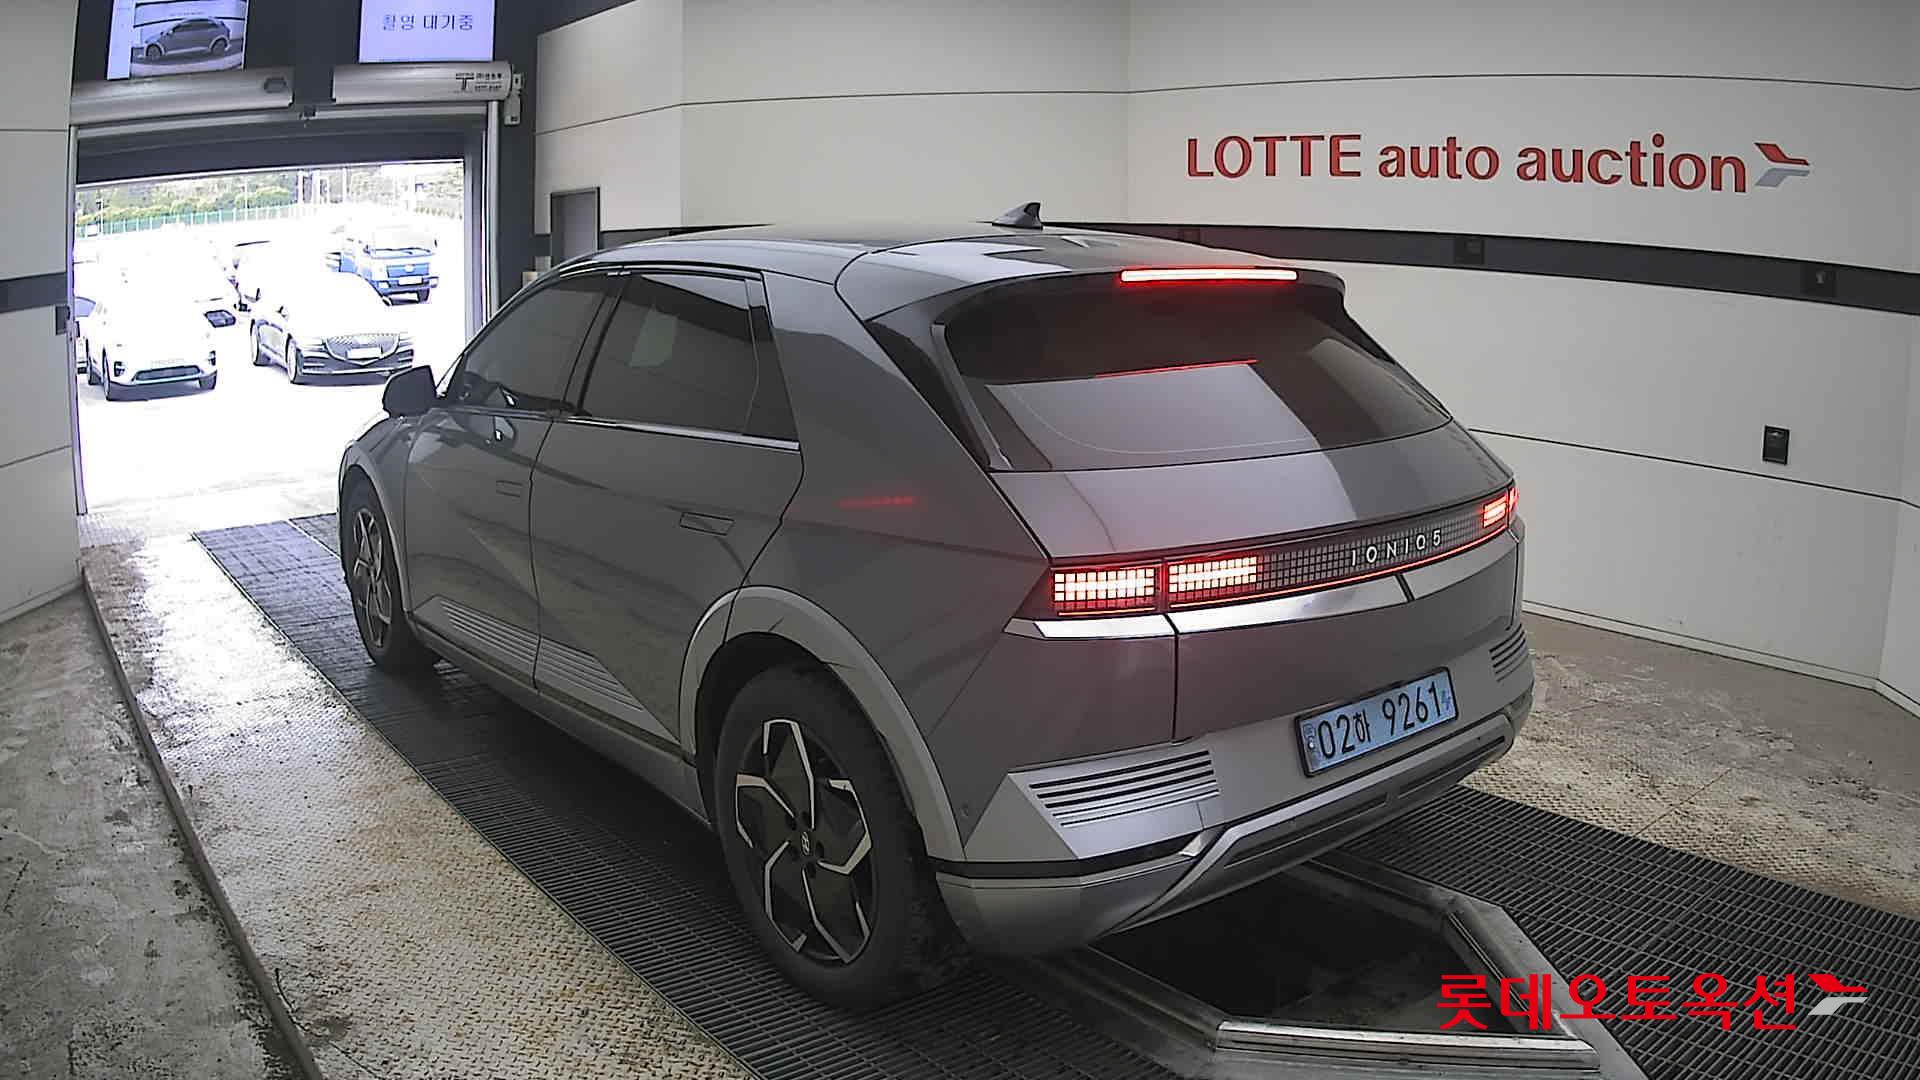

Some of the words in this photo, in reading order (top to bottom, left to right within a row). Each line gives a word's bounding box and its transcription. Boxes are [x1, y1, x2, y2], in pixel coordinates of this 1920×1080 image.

[423, 14, 473, 31] 대기중
[1187, 135, 1360, 177] LOTTE
[1379, 136, 1500, 179] auto
[1516, 134, 1747, 192] auction
[1317, 708, 1372, 759] 02하
[1381, 681, 1442, 736] 9261
